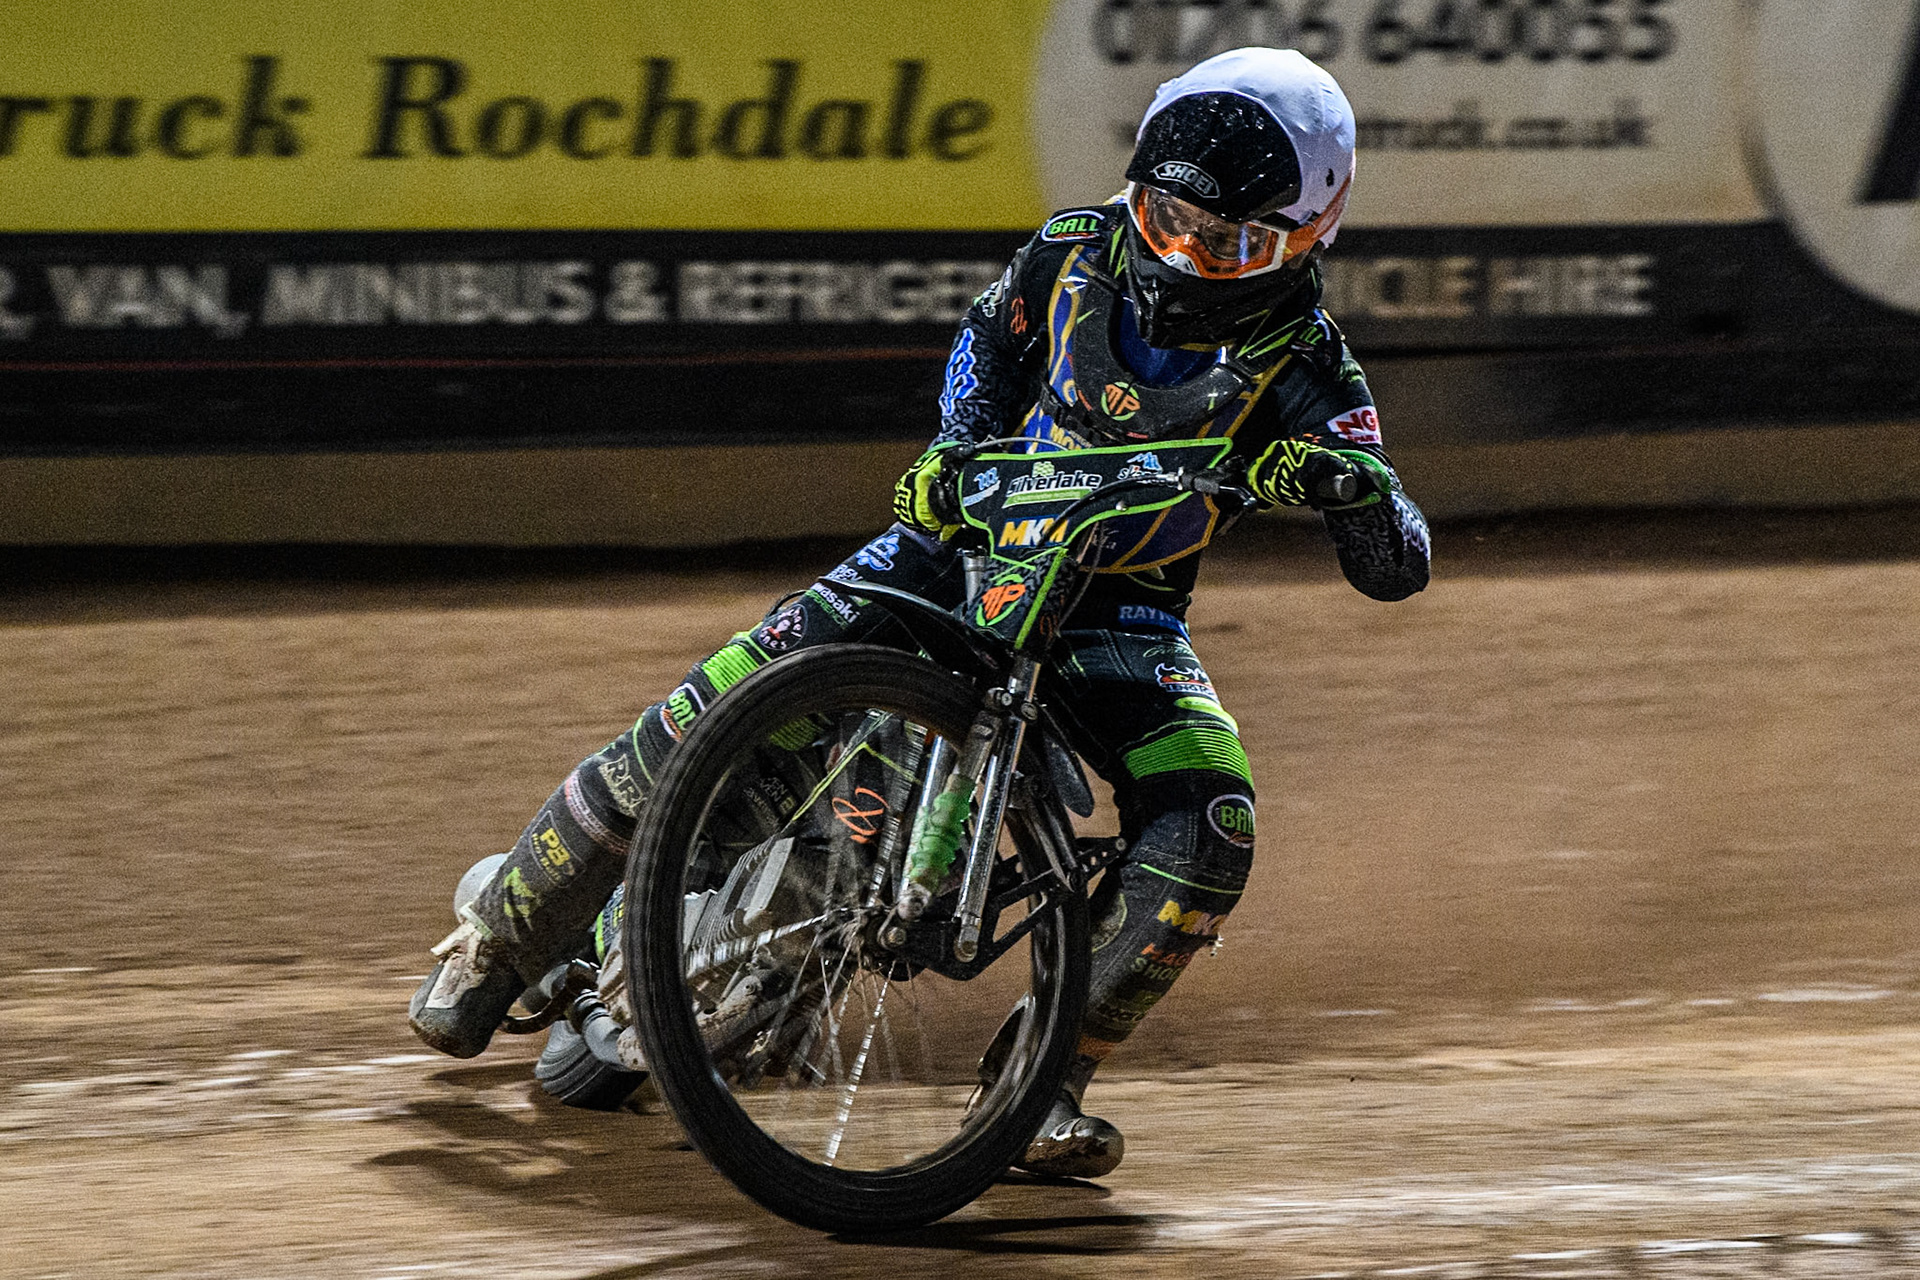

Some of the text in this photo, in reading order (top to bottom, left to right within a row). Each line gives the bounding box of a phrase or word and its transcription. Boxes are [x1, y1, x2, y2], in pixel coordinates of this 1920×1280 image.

[361, 54, 994, 162] Rochdale
[1160, 164, 1214, 194] SHOEI
[1048, 217, 1099, 235] BALL
[261, 262, 594, 325] MINIBUS
[605, 260, 668, 322] &
[678, 259, 1001, 323] REFRIGE
[1489, 254, 1656, 317] HIRE
[1006, 470, 1102, 497] Silverlake
